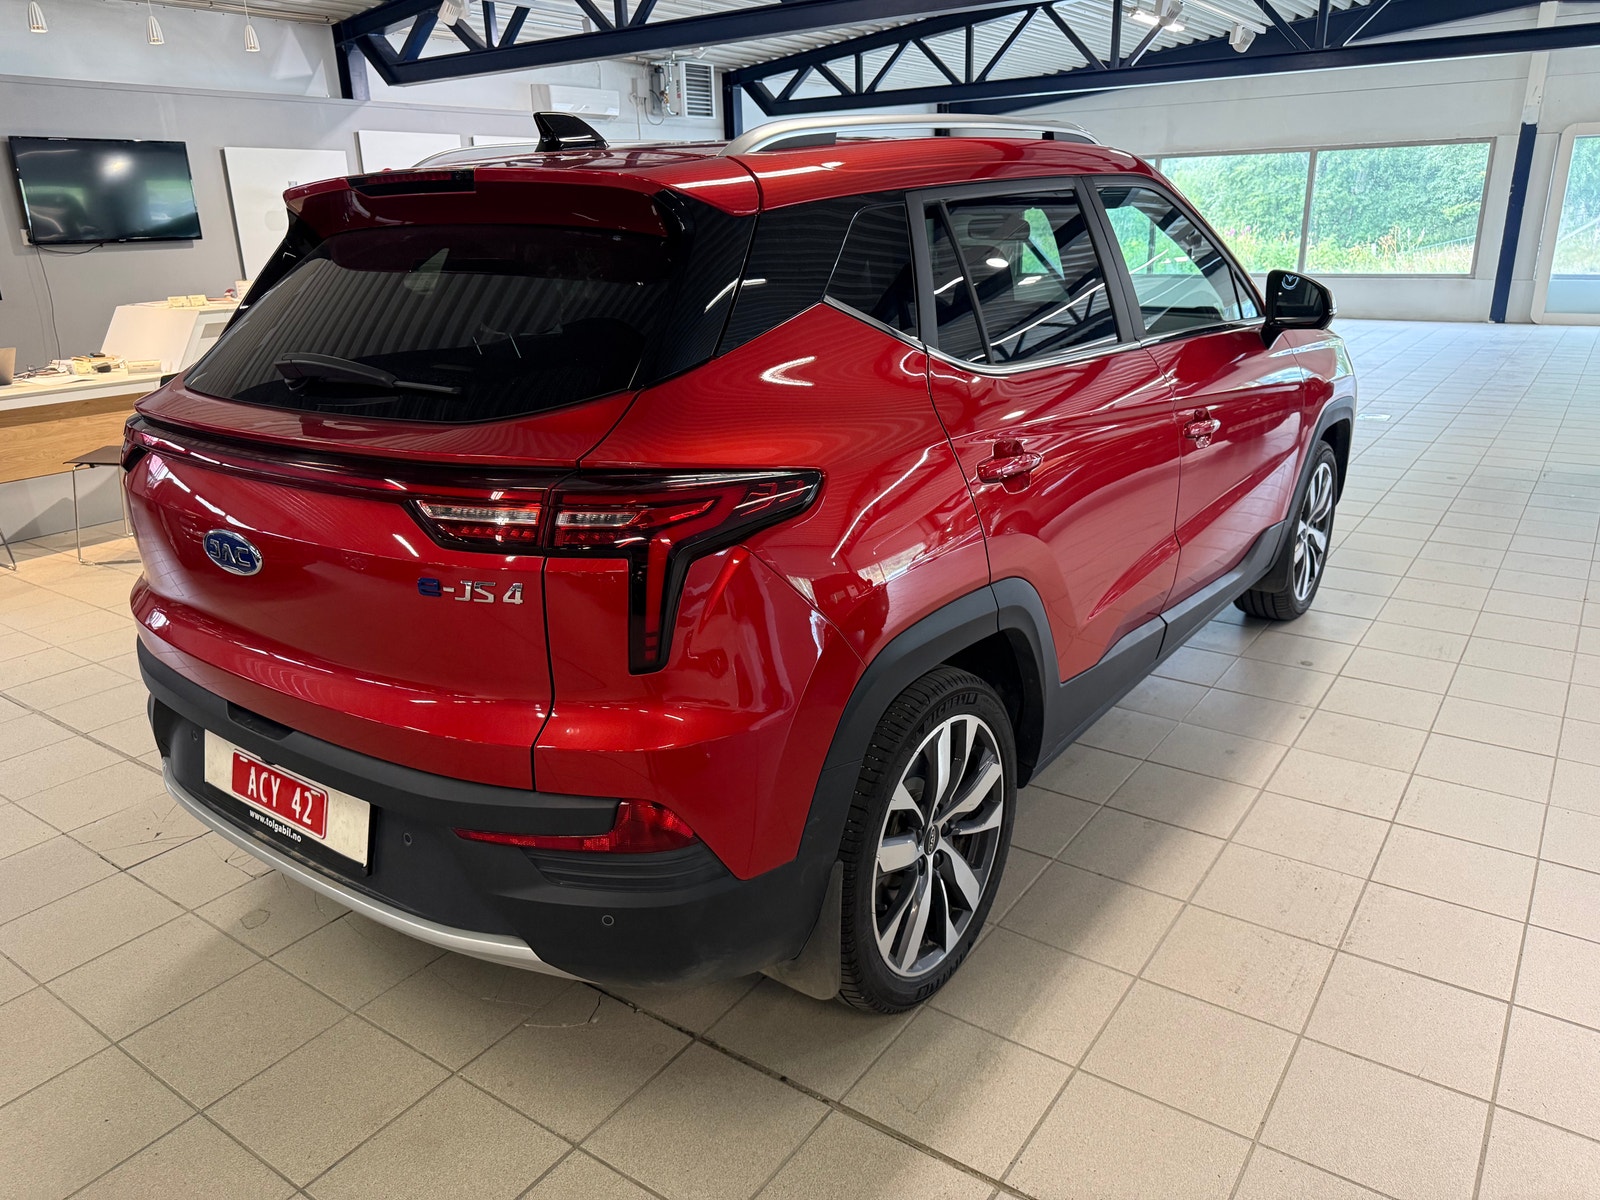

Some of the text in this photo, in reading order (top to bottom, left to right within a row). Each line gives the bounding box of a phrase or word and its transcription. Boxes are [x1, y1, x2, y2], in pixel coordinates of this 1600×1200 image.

[209, 538, 251, 567] JAC
[247, 766, 313, 825] ACY 42
[249, 809, 302, 843] www.tolgabil.no
